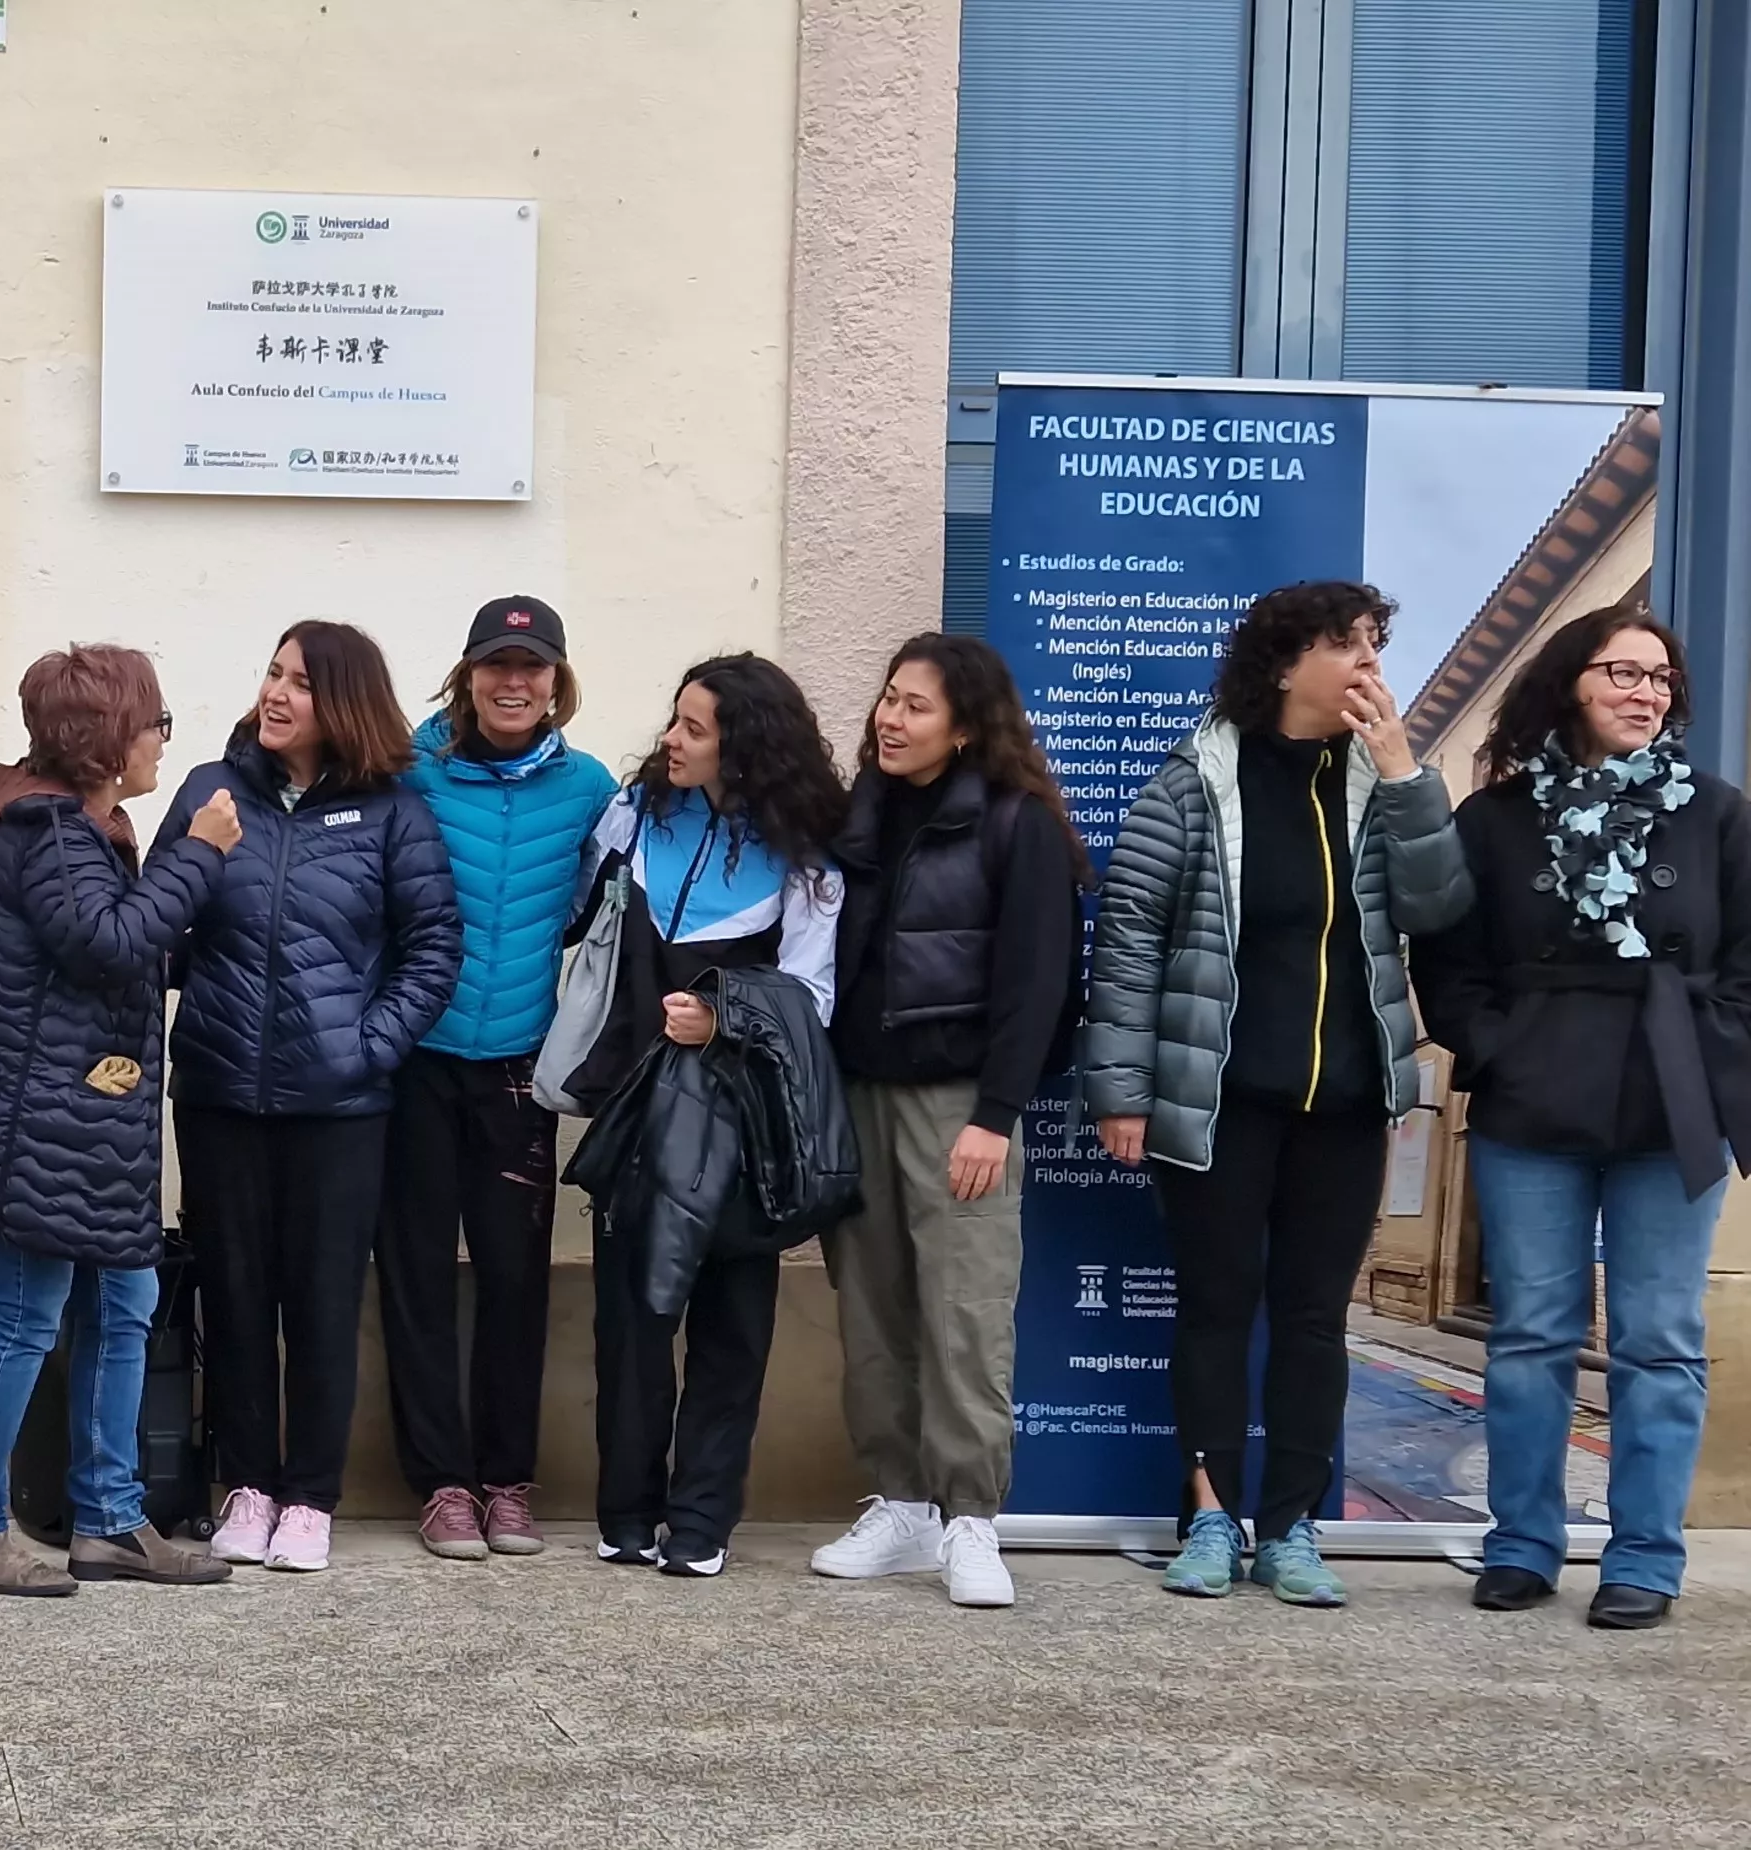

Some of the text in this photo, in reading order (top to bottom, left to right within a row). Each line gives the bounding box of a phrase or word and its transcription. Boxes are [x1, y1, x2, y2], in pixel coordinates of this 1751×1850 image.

[318, 216, 390, 230] Universidad
[319, 229, 364, 241] Zaragoza
[207, 301, 444, 319] Instituto Confucio de la Universidad de Zaragoza
[191, 383, 447, 402] Aula Confucio del Campus de Huesca
[1029, 415, 1336, 445] FACULTAD DE CIENCIAS
[1059, 453, 1306, 481] HUMANAS Y DE LA
[1100, 490, 1261, 518] EDUCACIÓN
[1019, 553, 1185, 573] Estudios de Grado:
[1029, 590, 1116, 610] Magisterio
[1120, 595, 1142, 608] en
[1145, 591, 1229, 610] Educación
[1049, 614, 1121, 632] Mención
[1125, 615, 1199, 633] Atención
[1202, 621, 1212, 634] a
[1215, 617, 1231, 634] la
[1048, 638, 1120, 656] Mención
[1124, 639, 1208, 657] Educación
[1072, 662, 1132, 684] (Inglés)
[1047, 686, 1118, 704] Mención
[1123, 688, 1183, 710] Lengua
[1025, 710, 1203, 731] Magisterio en Educac
[1045, 734, 1117, 752] Mención
[1045, 758, 1116, 776] Mención
[1056, 782, 1115, 799] ención
[324, 809, 361, 827] COLMAR
[1035, 1167, 1103, 1188] Filología
[1122, 1266, 1175, 1276] Facultad de
[1122, 1280, 1160, 1290] Ciencias
[1026, 1403, 1127, 1418] @HuescaFCHE
[1026, 1421, 1067, 1436] @Fac.
[1070, 1421, 1127, 1435] Ciencias
